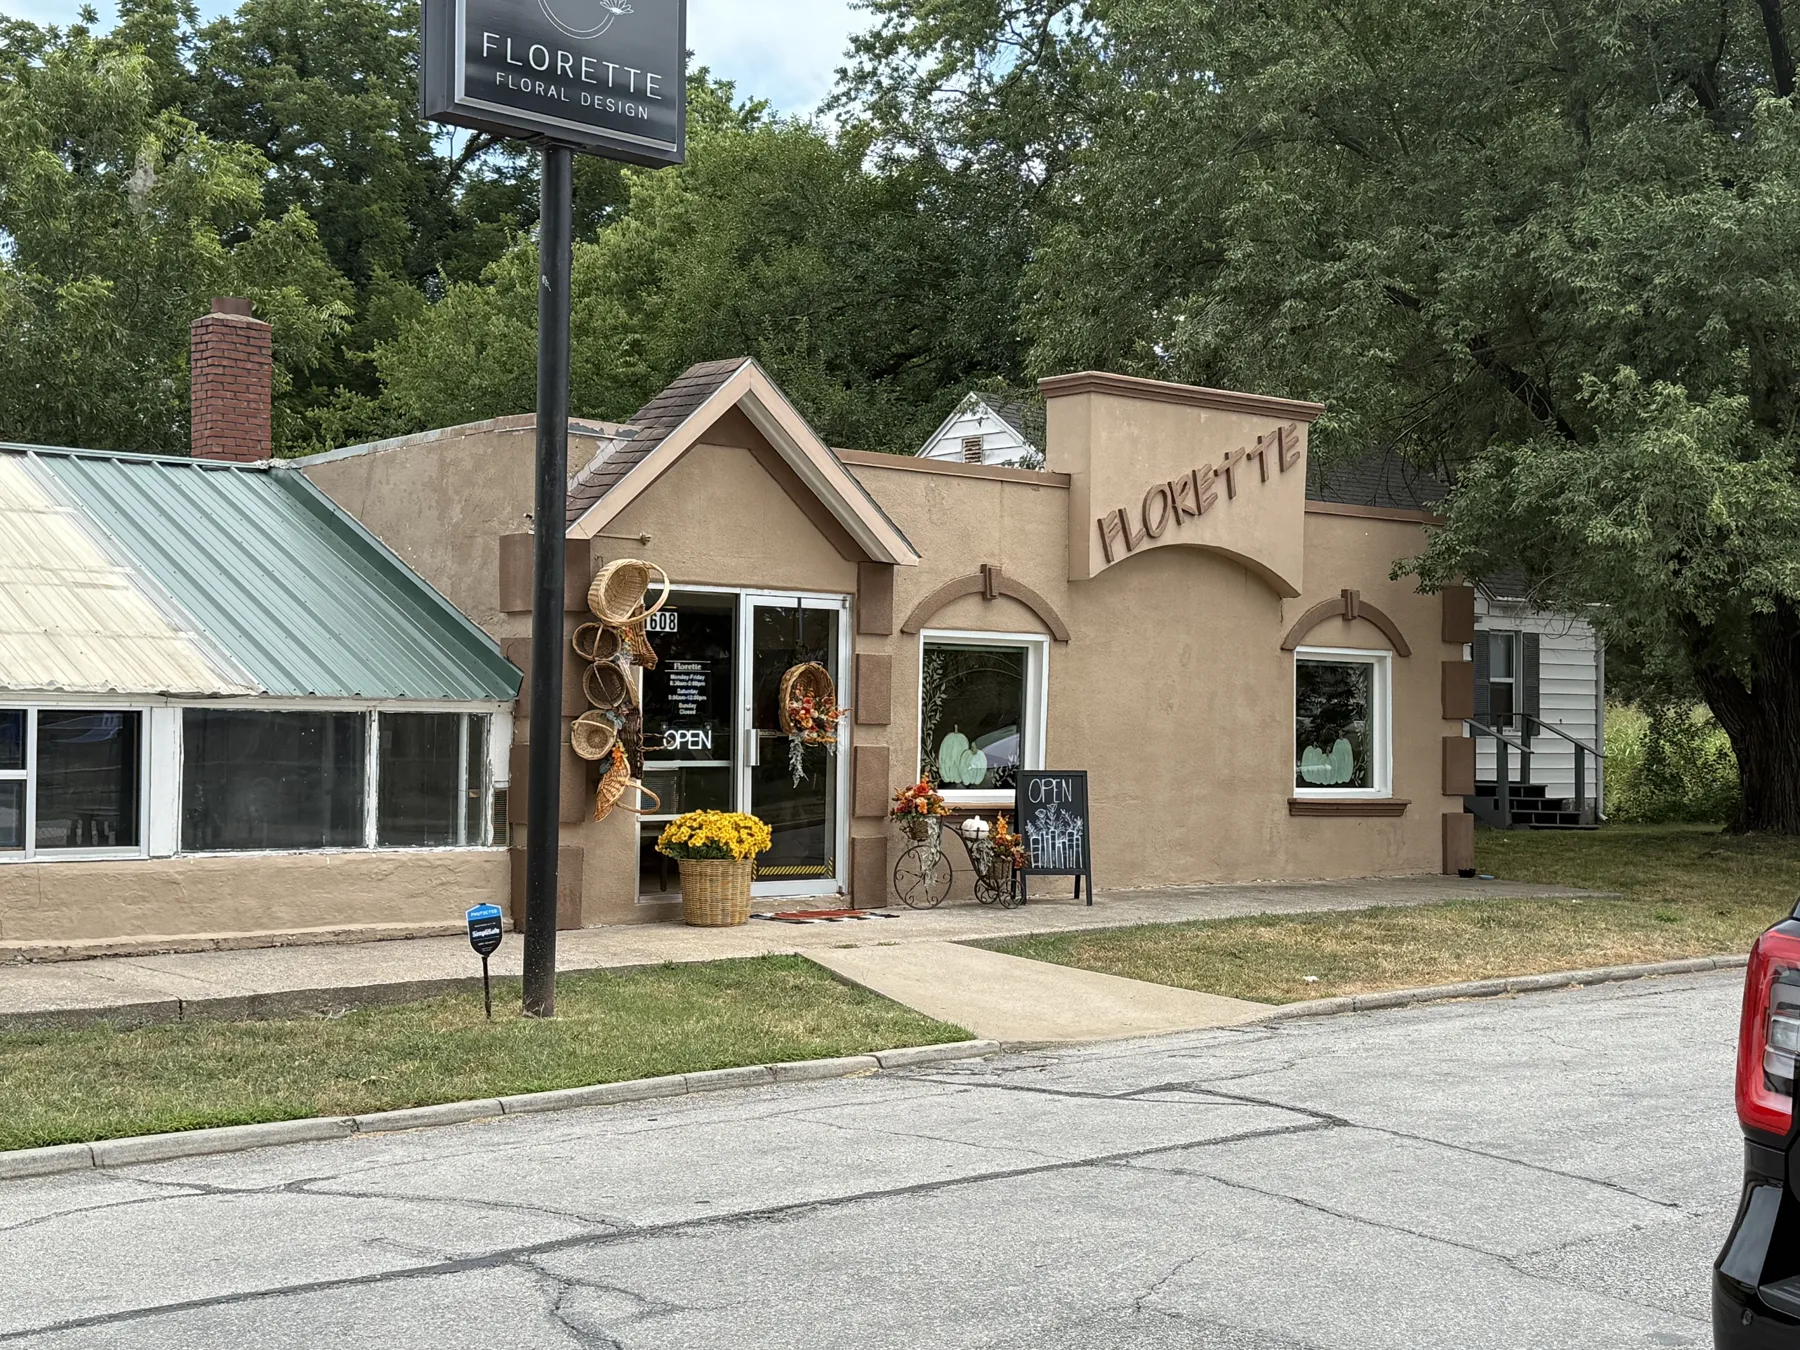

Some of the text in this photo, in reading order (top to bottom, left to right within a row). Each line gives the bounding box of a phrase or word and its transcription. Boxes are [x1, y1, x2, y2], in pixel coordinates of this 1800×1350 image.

[483, 31, 662, 99] FLORETTE
[496, 72, 649, 120] FLORAL DESIGN
[1097, 423, 1300, 563] FLORETTE
[673, 663, 702, 671] Florette
[663, 730, 711, 750] OPEN
[1028, 778, 1072, 803] OPEN
